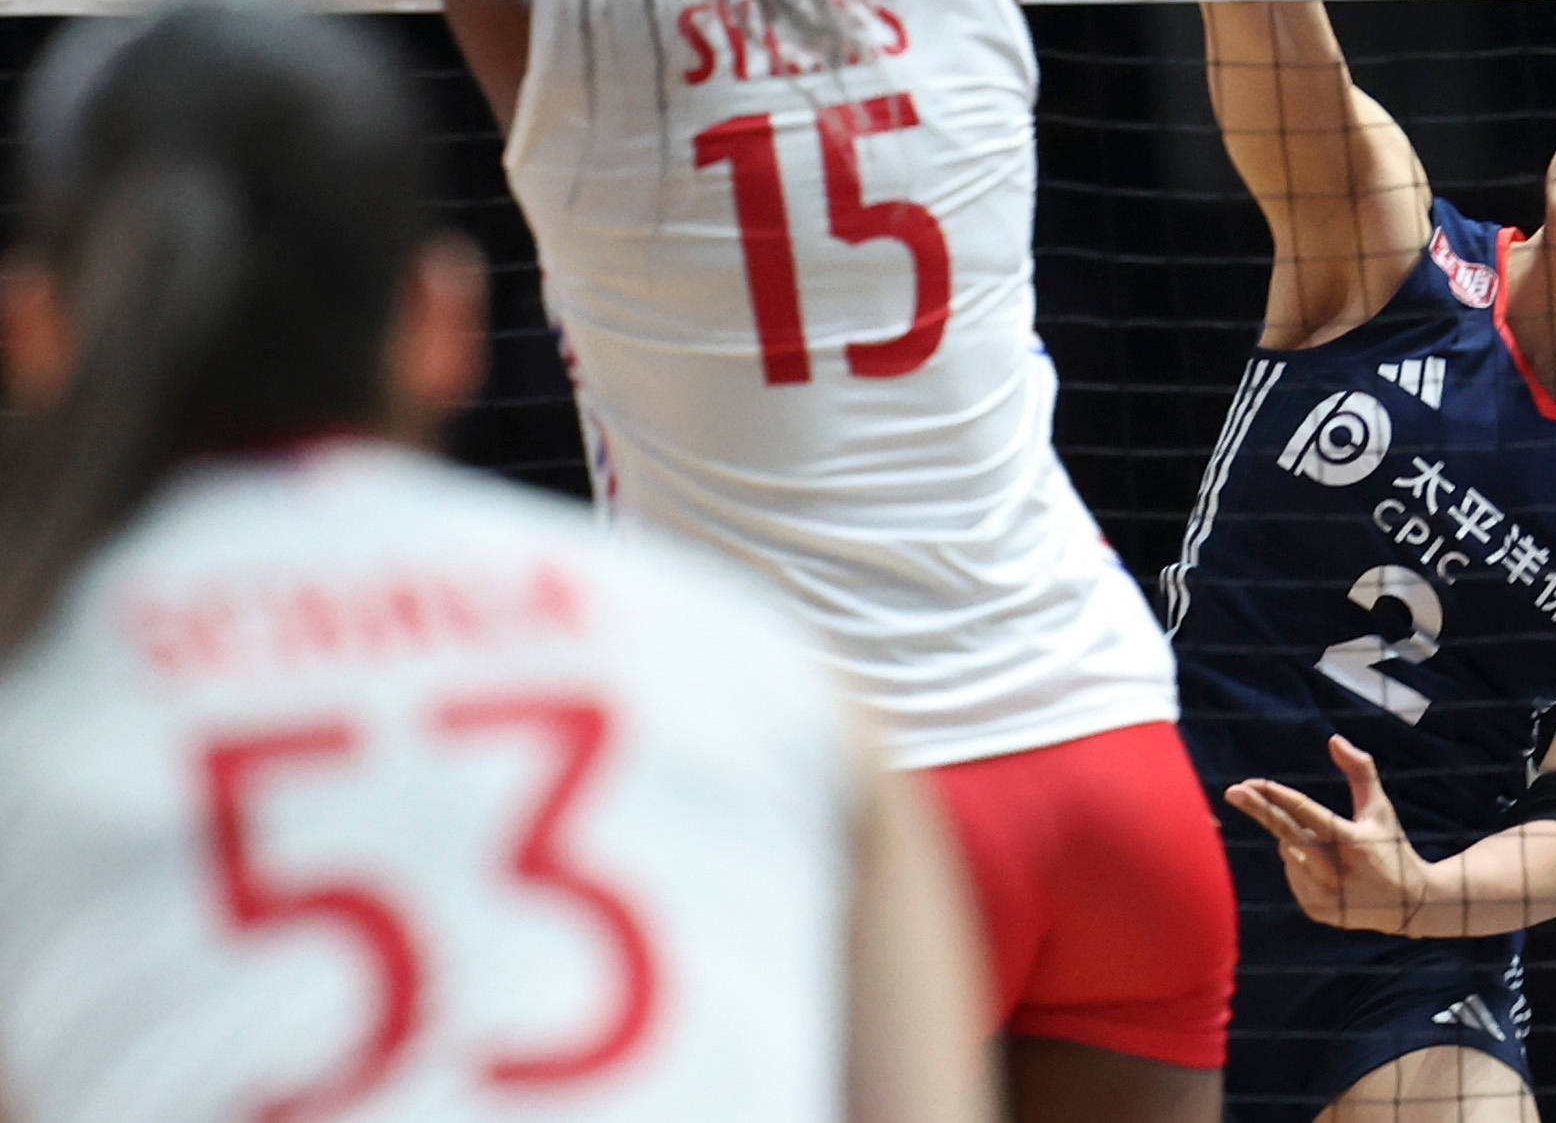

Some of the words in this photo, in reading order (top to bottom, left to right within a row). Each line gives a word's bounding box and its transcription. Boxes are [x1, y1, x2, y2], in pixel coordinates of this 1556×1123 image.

[690, 91, 952, 387] 15
[1312, 564, 1444, 727] 2
[1372, 498, 1471, 586] CPIC
[193, 690, 668, 1123] 53
